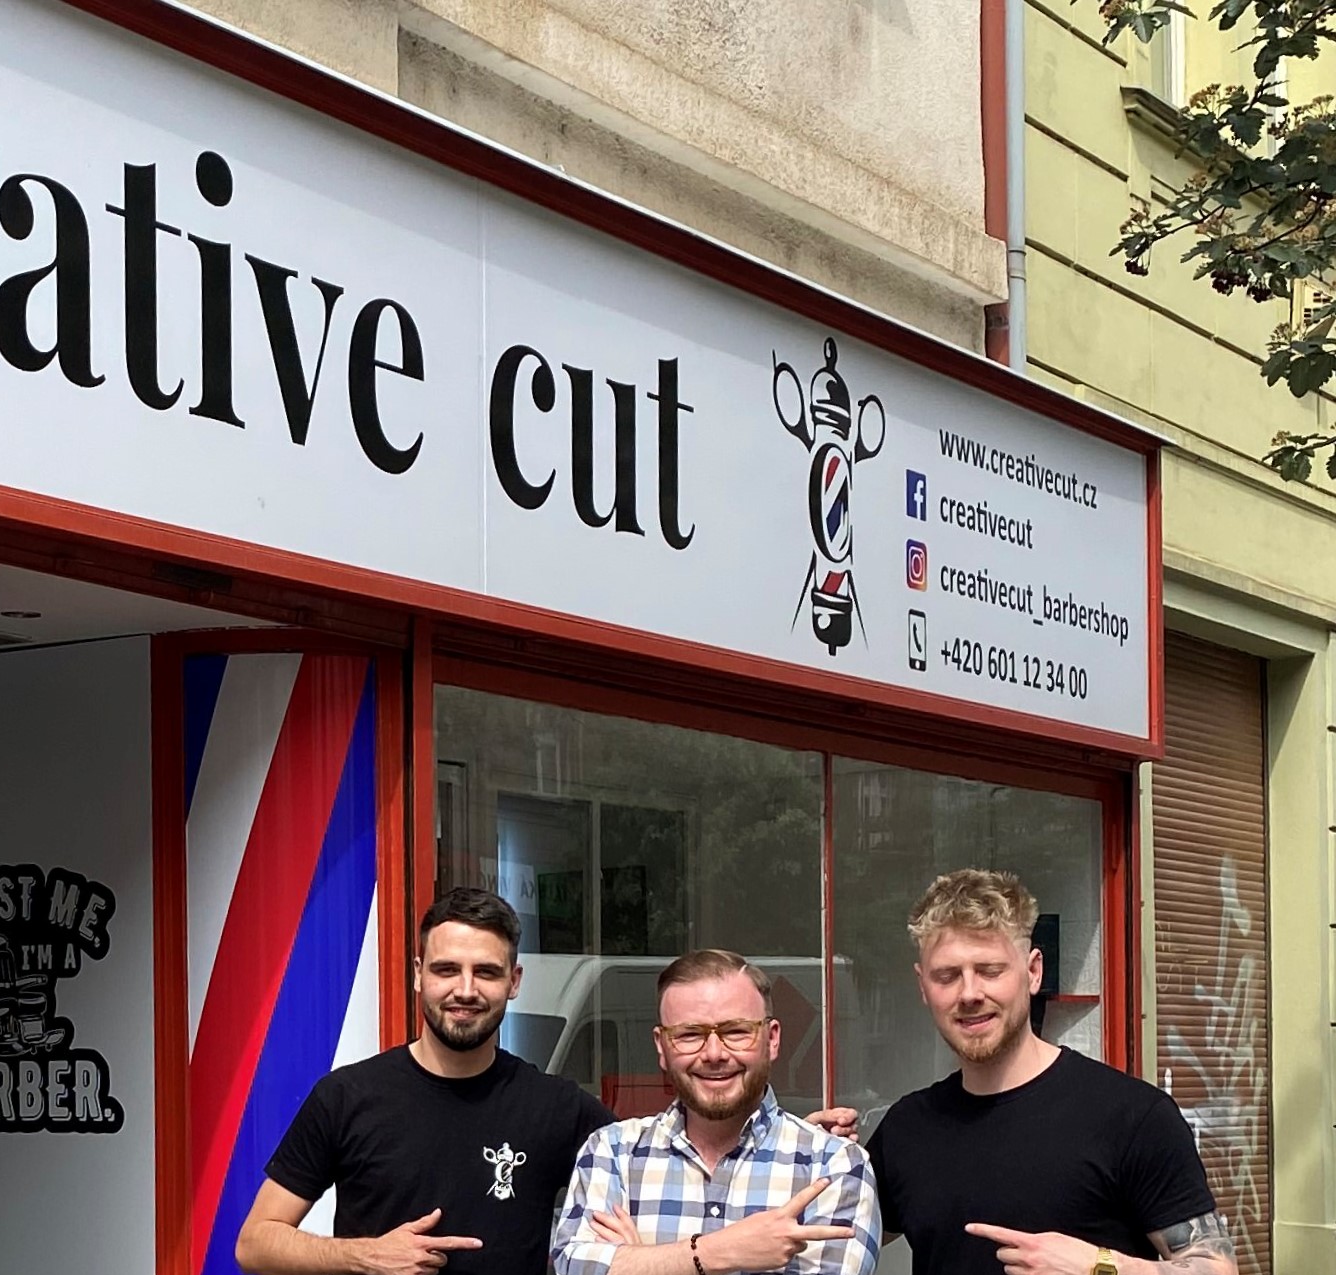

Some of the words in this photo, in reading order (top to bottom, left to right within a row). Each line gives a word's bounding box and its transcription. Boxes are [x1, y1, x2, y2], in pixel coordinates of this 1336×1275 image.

[488, 343, 697, 552] cut
[939, 428, 1098, 510] www.creativecut.cz
[939, 493, 1033, 549] creativecut
[940, 563, 1129, 646] creativecut_barbershop
[941, 636, 983, 676] +420
[988, 645, 1018, 684] 601
[1023, 655, 1042, 691] 12
[1046, 660, 1065, 695] 34
[1069, 667, 1088, 700] 00
[21, 943, 53, 971] I'M
[64, 943, 77, 969] A
